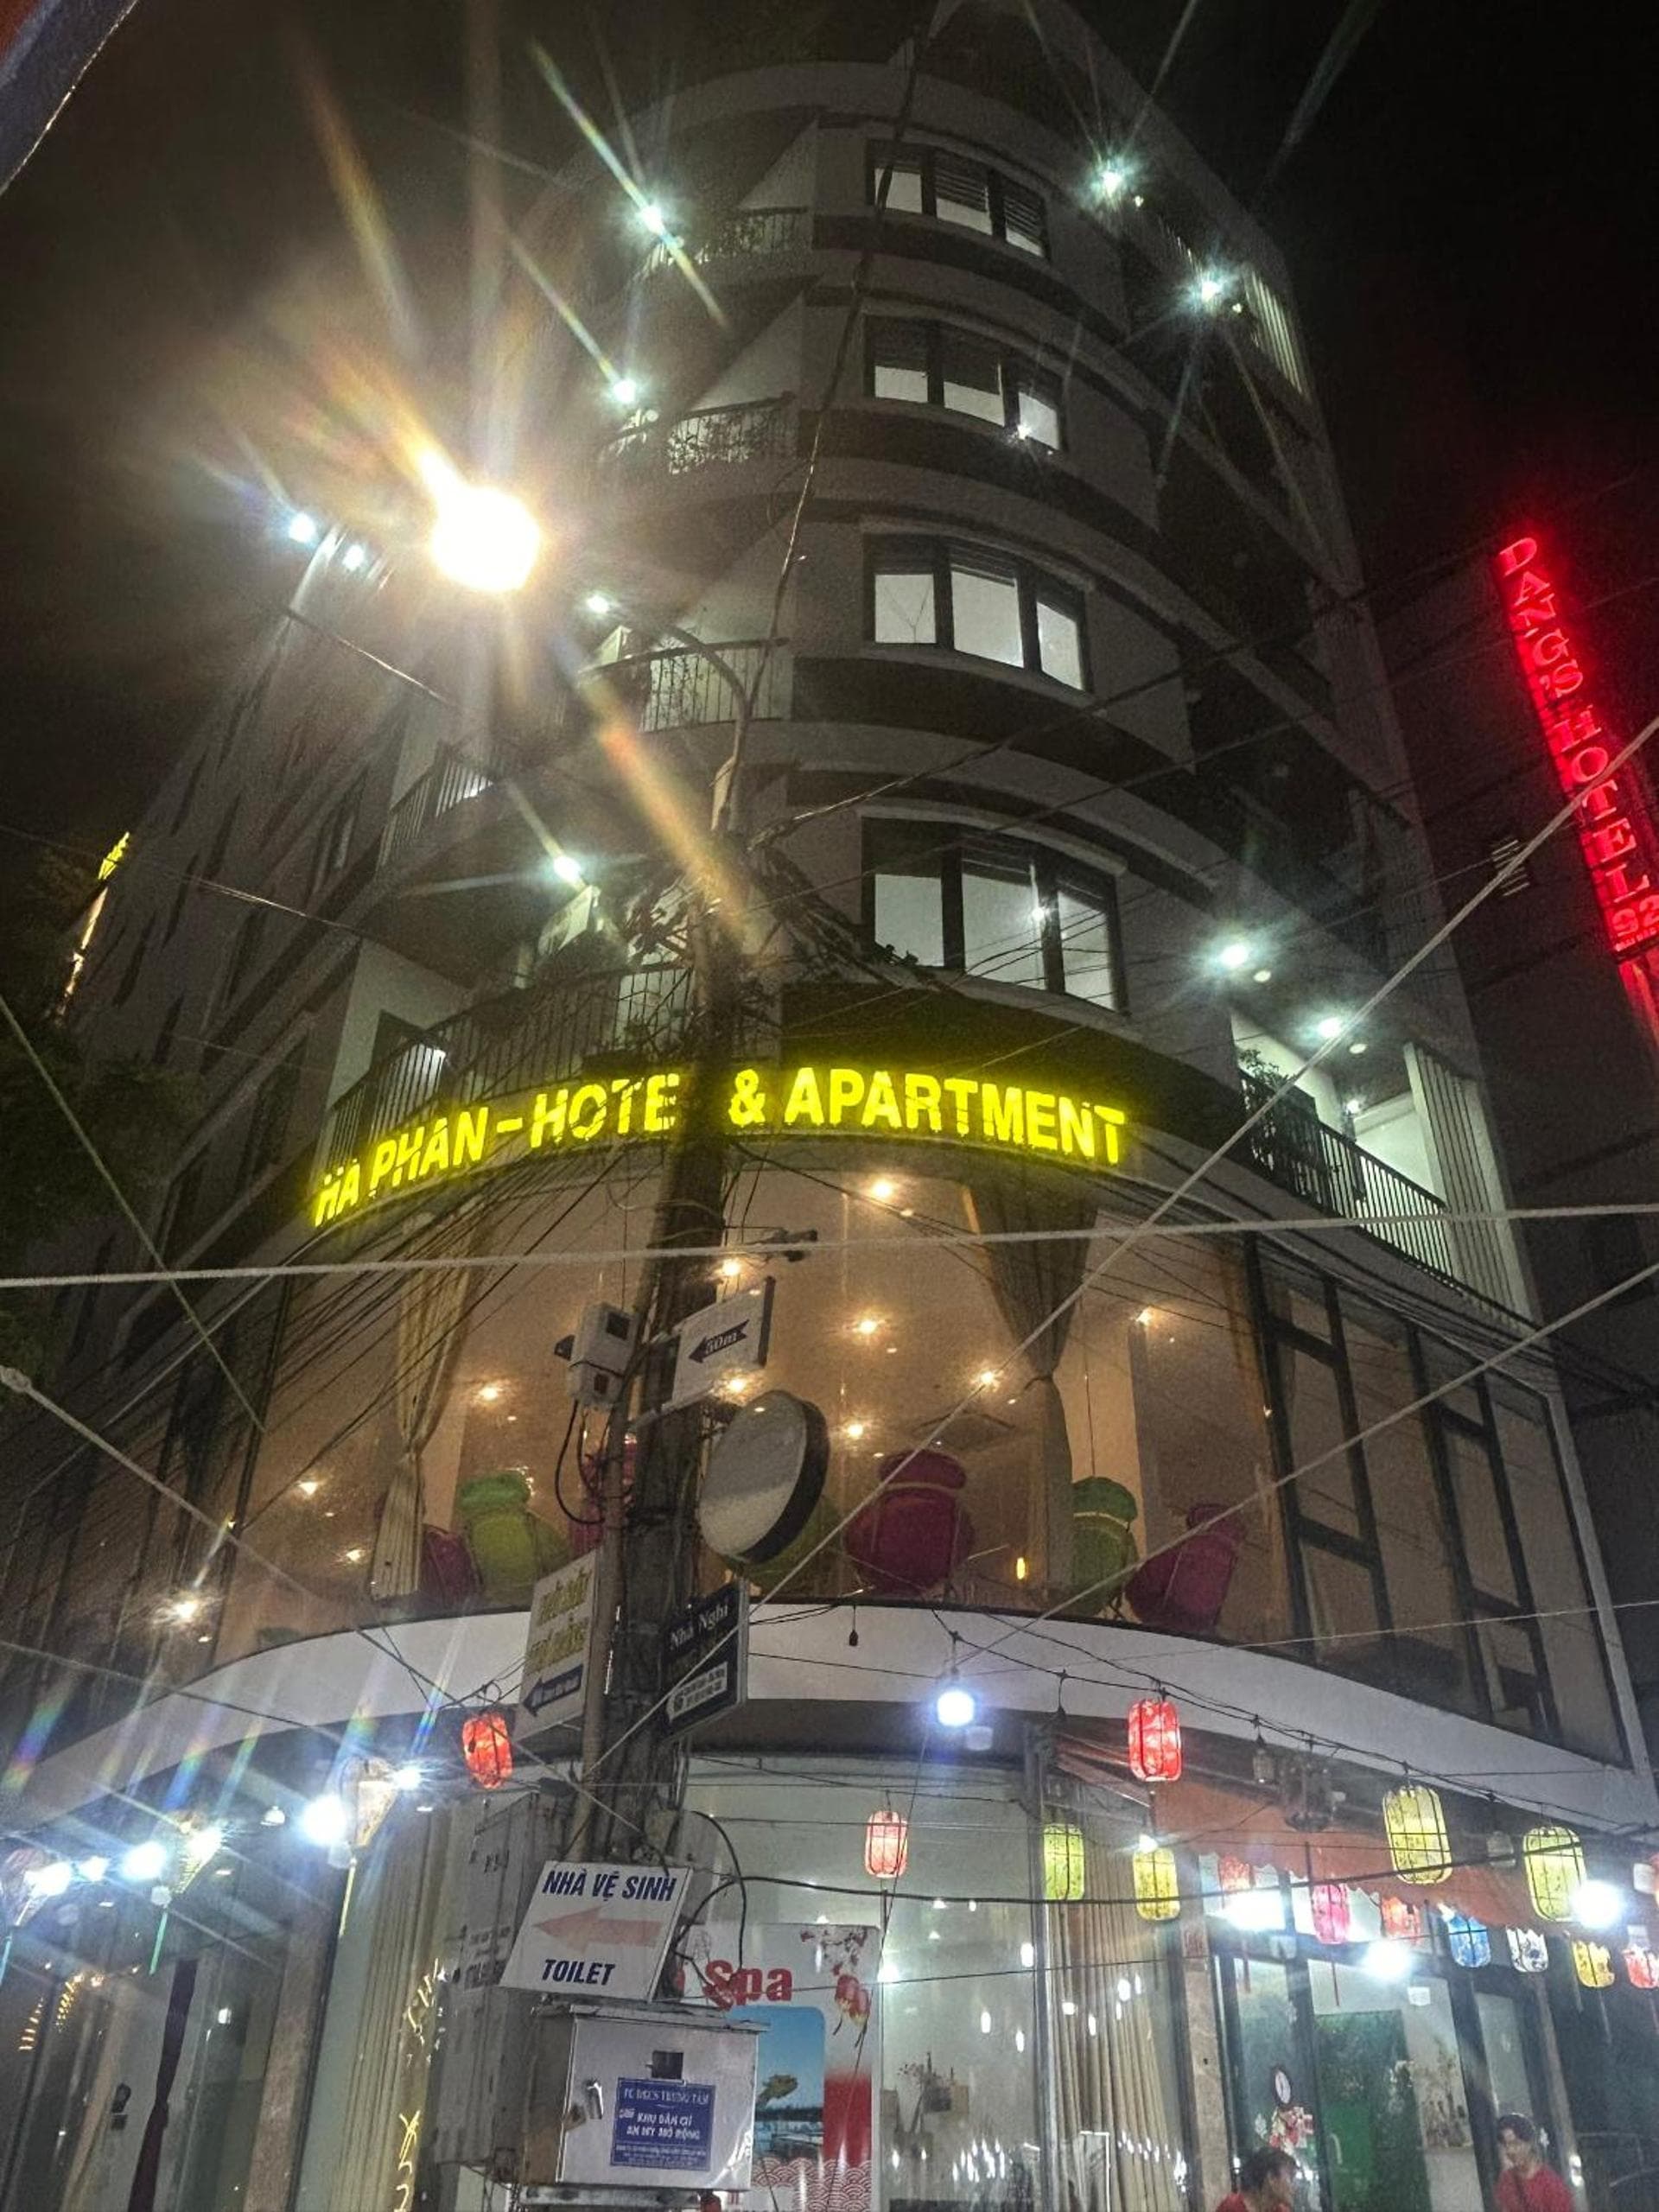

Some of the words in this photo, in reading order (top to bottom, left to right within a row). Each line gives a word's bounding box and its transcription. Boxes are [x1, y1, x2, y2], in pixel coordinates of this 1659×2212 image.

[1546, 703, 1650, 904] HOTEL
[530, 1072, 681, 1148] HOTE
[728, 1068, 766, 1128] &
[784, 1067, 1126, 1165] APARTMENT
[542, 1868, 588, 1897] NHÀ
[592, 1871, 620, 1902] VỆ
[621, 1875, 677, 1902] SINH
[542, 1959, 616, 1986] TOILET
[702, 1960, 792, 2012] Spa
